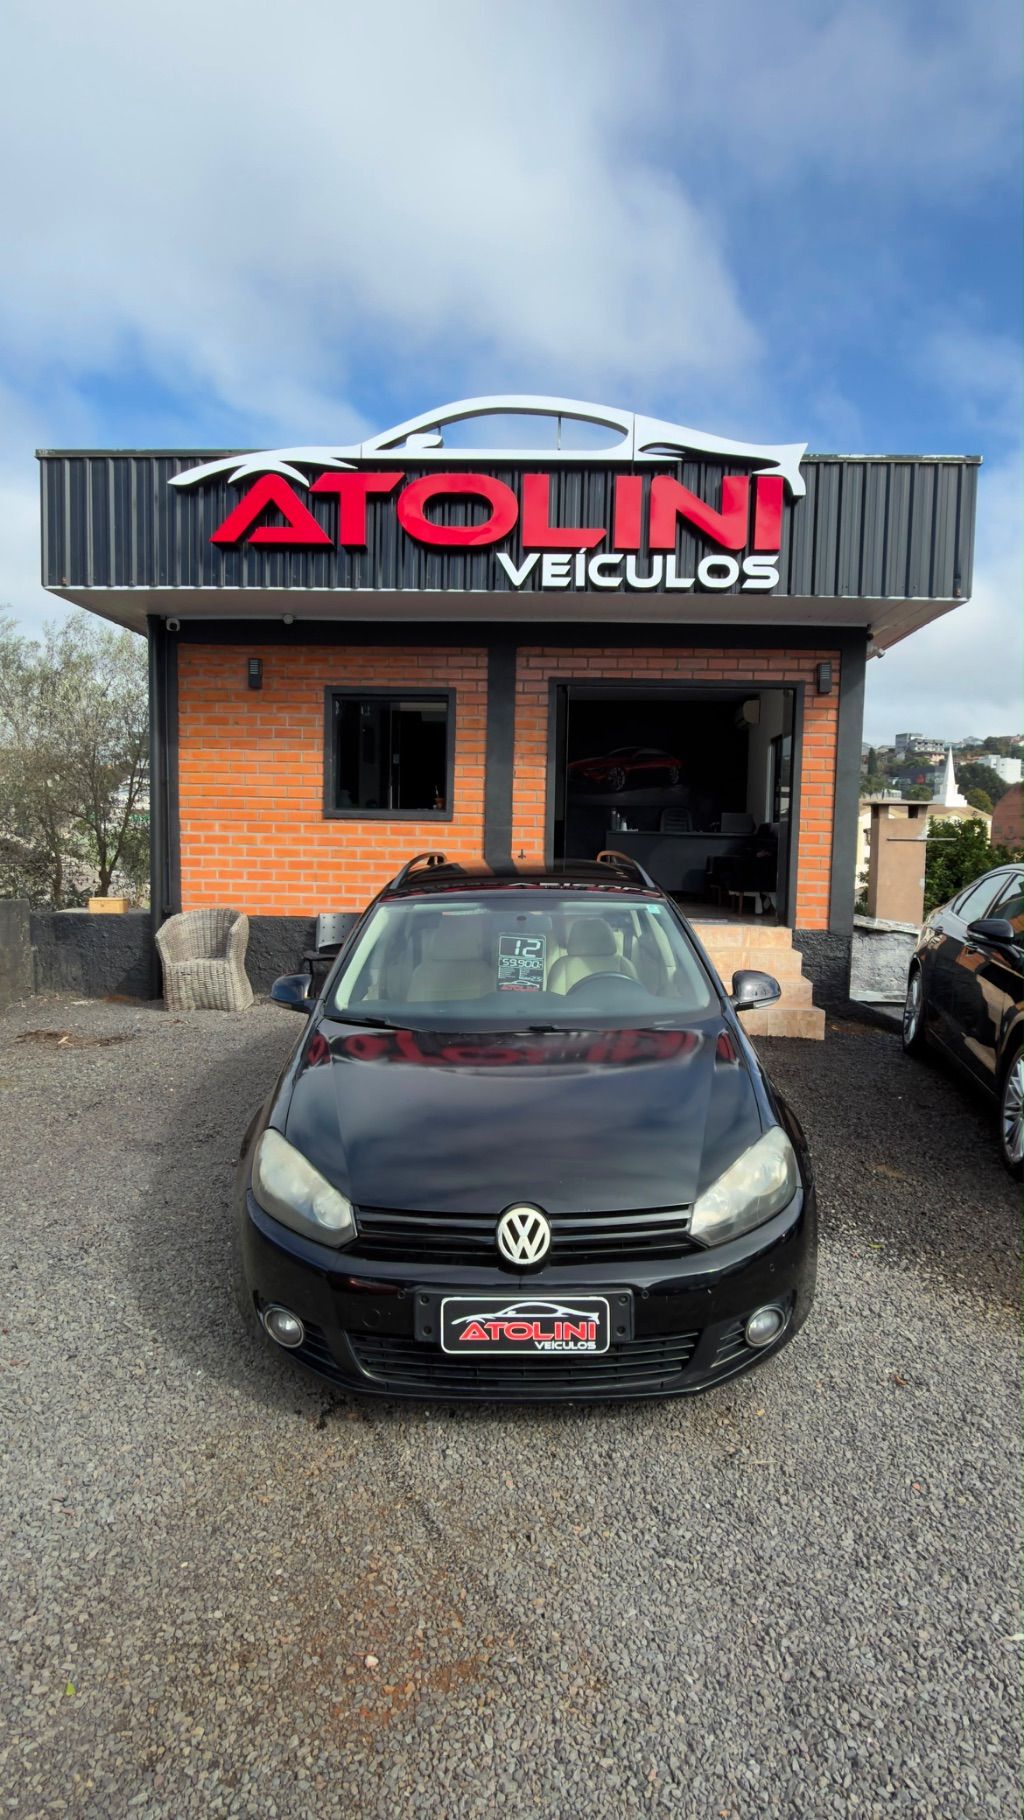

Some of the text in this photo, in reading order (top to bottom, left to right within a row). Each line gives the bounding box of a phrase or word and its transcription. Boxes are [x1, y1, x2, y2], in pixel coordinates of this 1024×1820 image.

[209, 473, 784, 549] ATOLINI
[496, 548, 781, 591] VEÍCULOS
[515, 940, 541, 957] 12
[459, 1321, 596, 1341] ATOLINI
